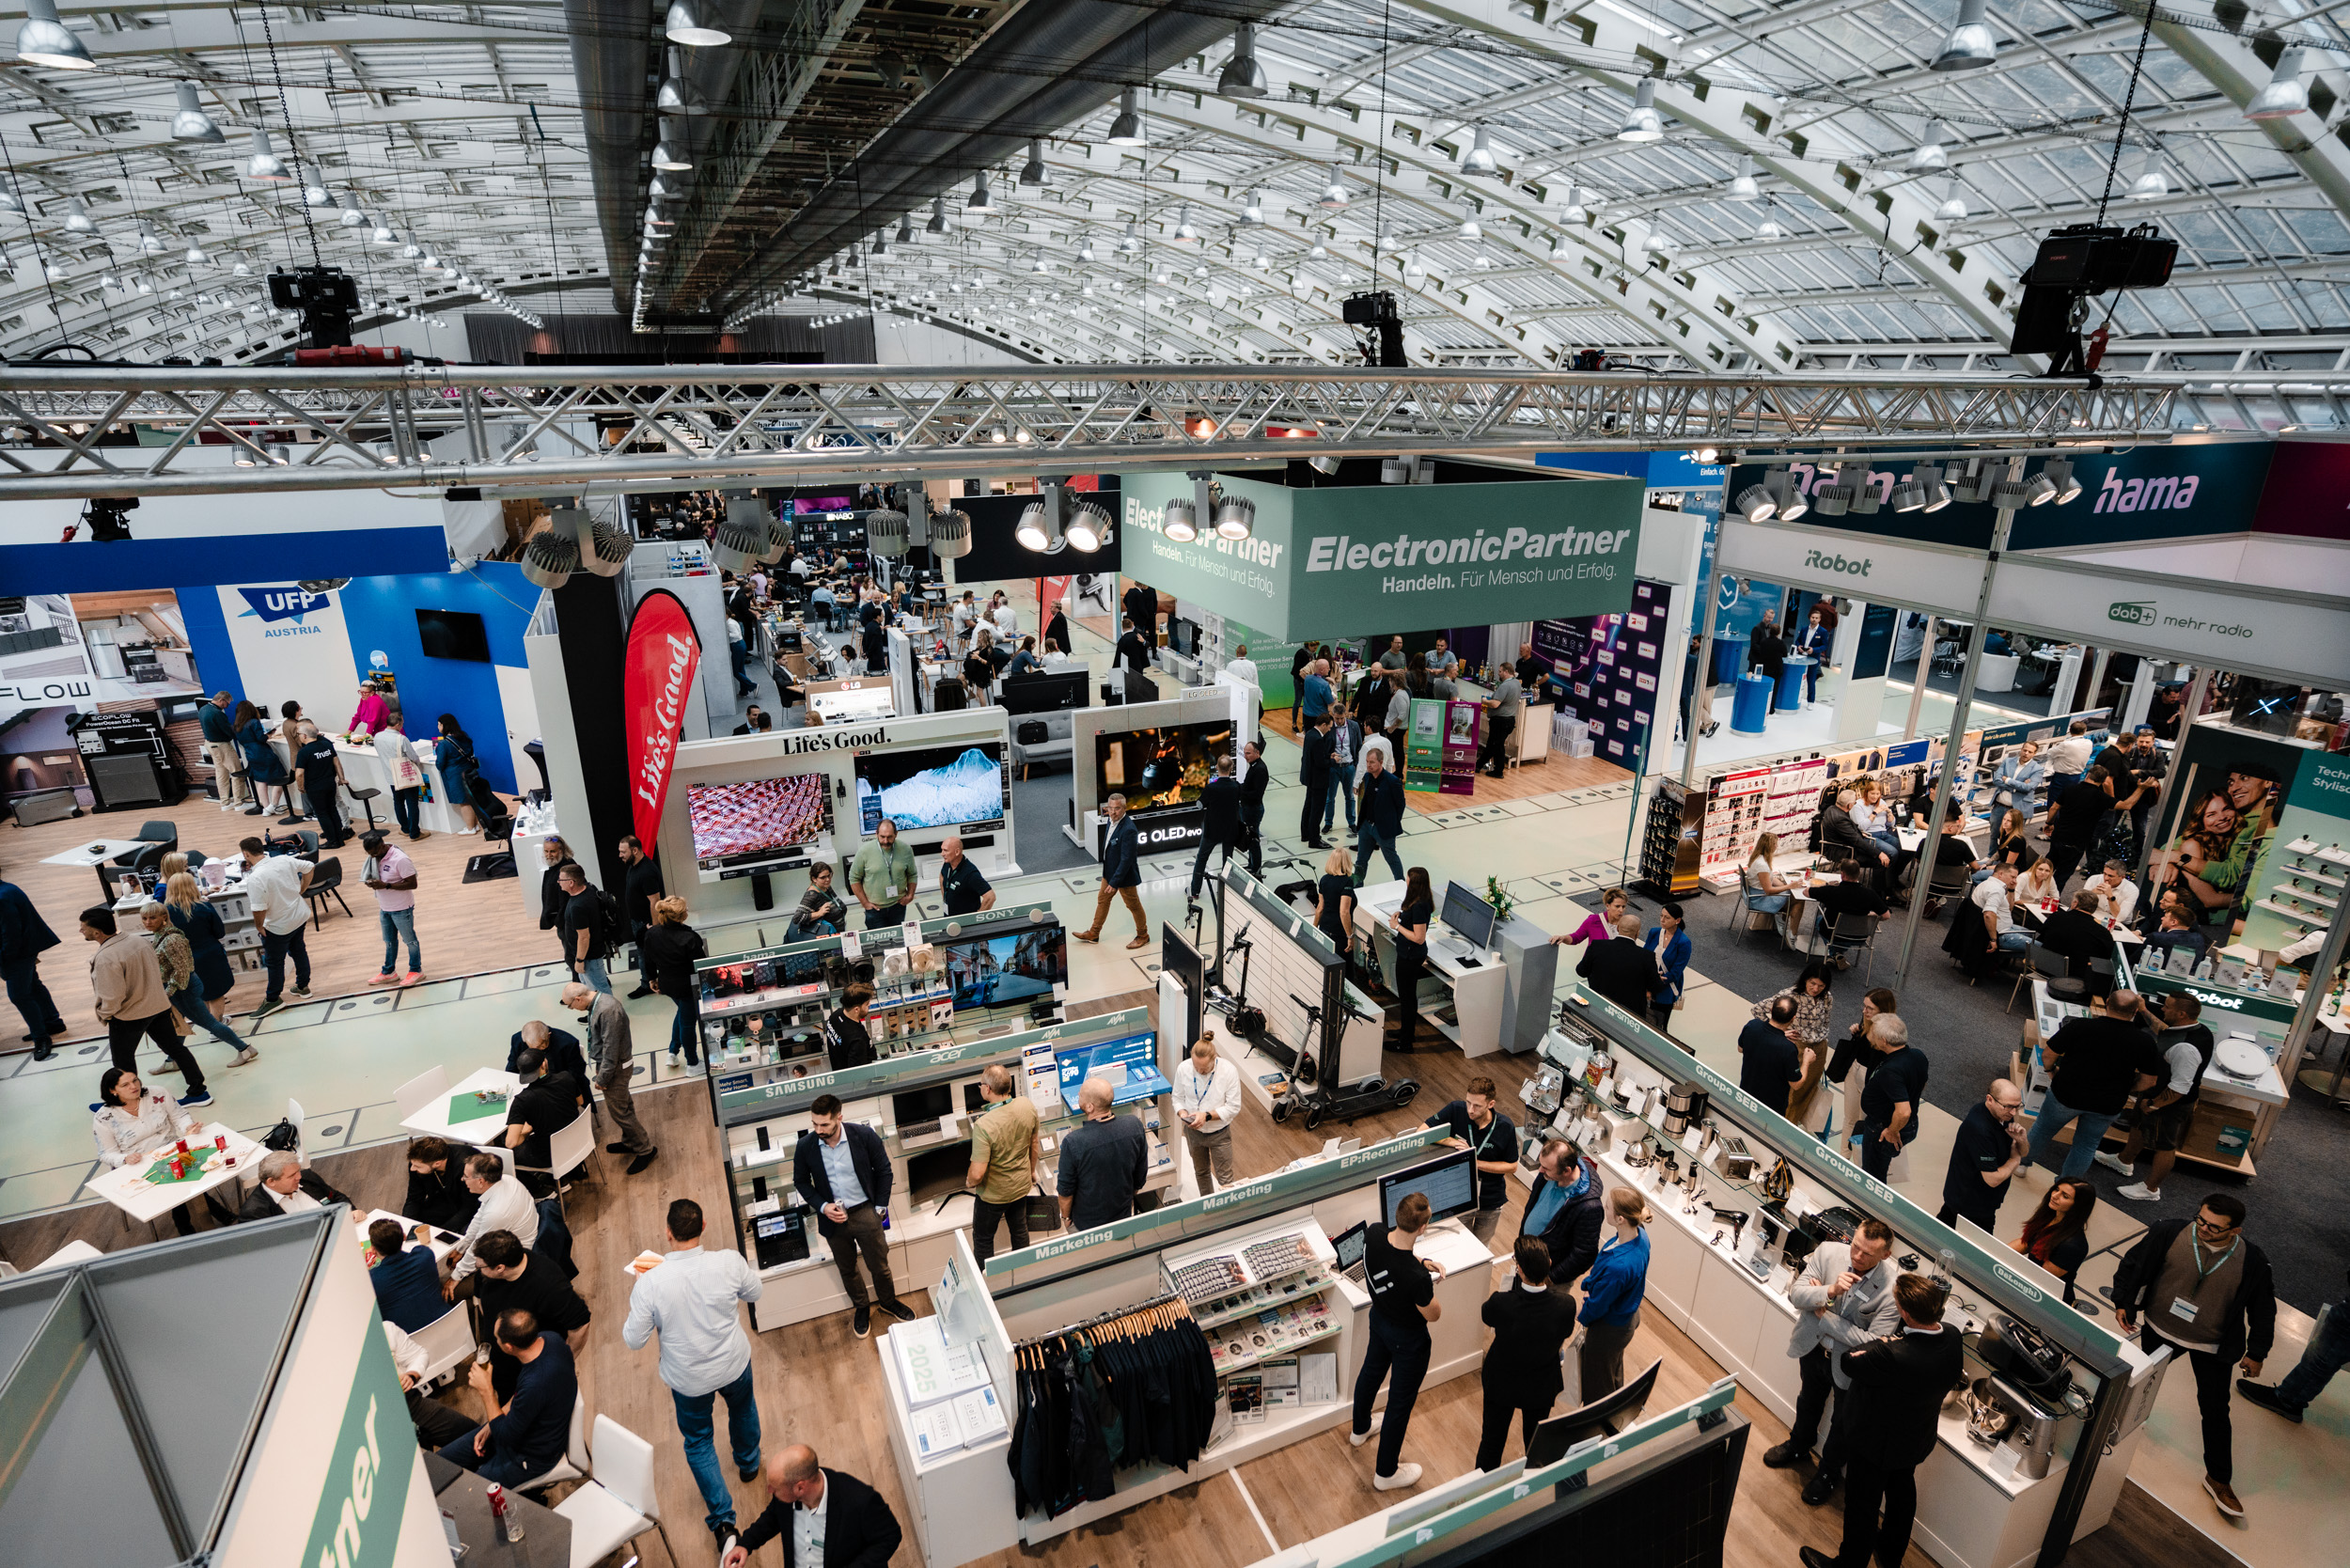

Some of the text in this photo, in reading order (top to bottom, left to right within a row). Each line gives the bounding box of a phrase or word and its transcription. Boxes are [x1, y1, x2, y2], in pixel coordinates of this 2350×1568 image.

[2092, 466, 2200, 514] hama
[1125, 496, 1283, 569] ElectcPartner
[1306, 526, 1631, 572] ElectronicPartner
[1805, 549, 1872, 577] iRobot
[1152, 540, 1276, 598] Handeln. Für Mensch und Erfolg.
[1383, 562, 1618, 593] Handeln. Für Mensch und Erfolg.
[265, 591, 316, 611] UFP
[265, 625, 321, 637] AUSTRIA
[2164, 614, 2206, 631] mehr
[2209, 622, 2253, 639] radio
[1198, 689, 1217, 698] OLED
[638, 633, 693, 809] Life's Good.
[314, 749, 331, 760] Trust
[783, 727, 892, 756] Life's Good.
[1151, 826, 1186, 842] OLED
[1186, 827, 1202, 837] evo
[976, 908, 1017, 921] SONY
[866, 929, 898, 942] hama
[743, 951, 776, 962] hama
[1618, 1011, 1640, 1033] smeg
[930, 1047, 966, 1065] acer
[765, 1075, 835, 1098] SAMSUNG
[1695, 1065, 1759, 1113] Groupe SEB
[1340, 1137, 1425, 1168] EP:Recruiting
[1815, 1146, 1894, 1204] Groupe SEB
[1202, 1183, 1272, 1211] Marketing
[1035, 1230, 1114, 1261] Marketing
[1997, 1266, 2038, 1300] DeLonghi
[907, 1344, 938, 1393] 2025
